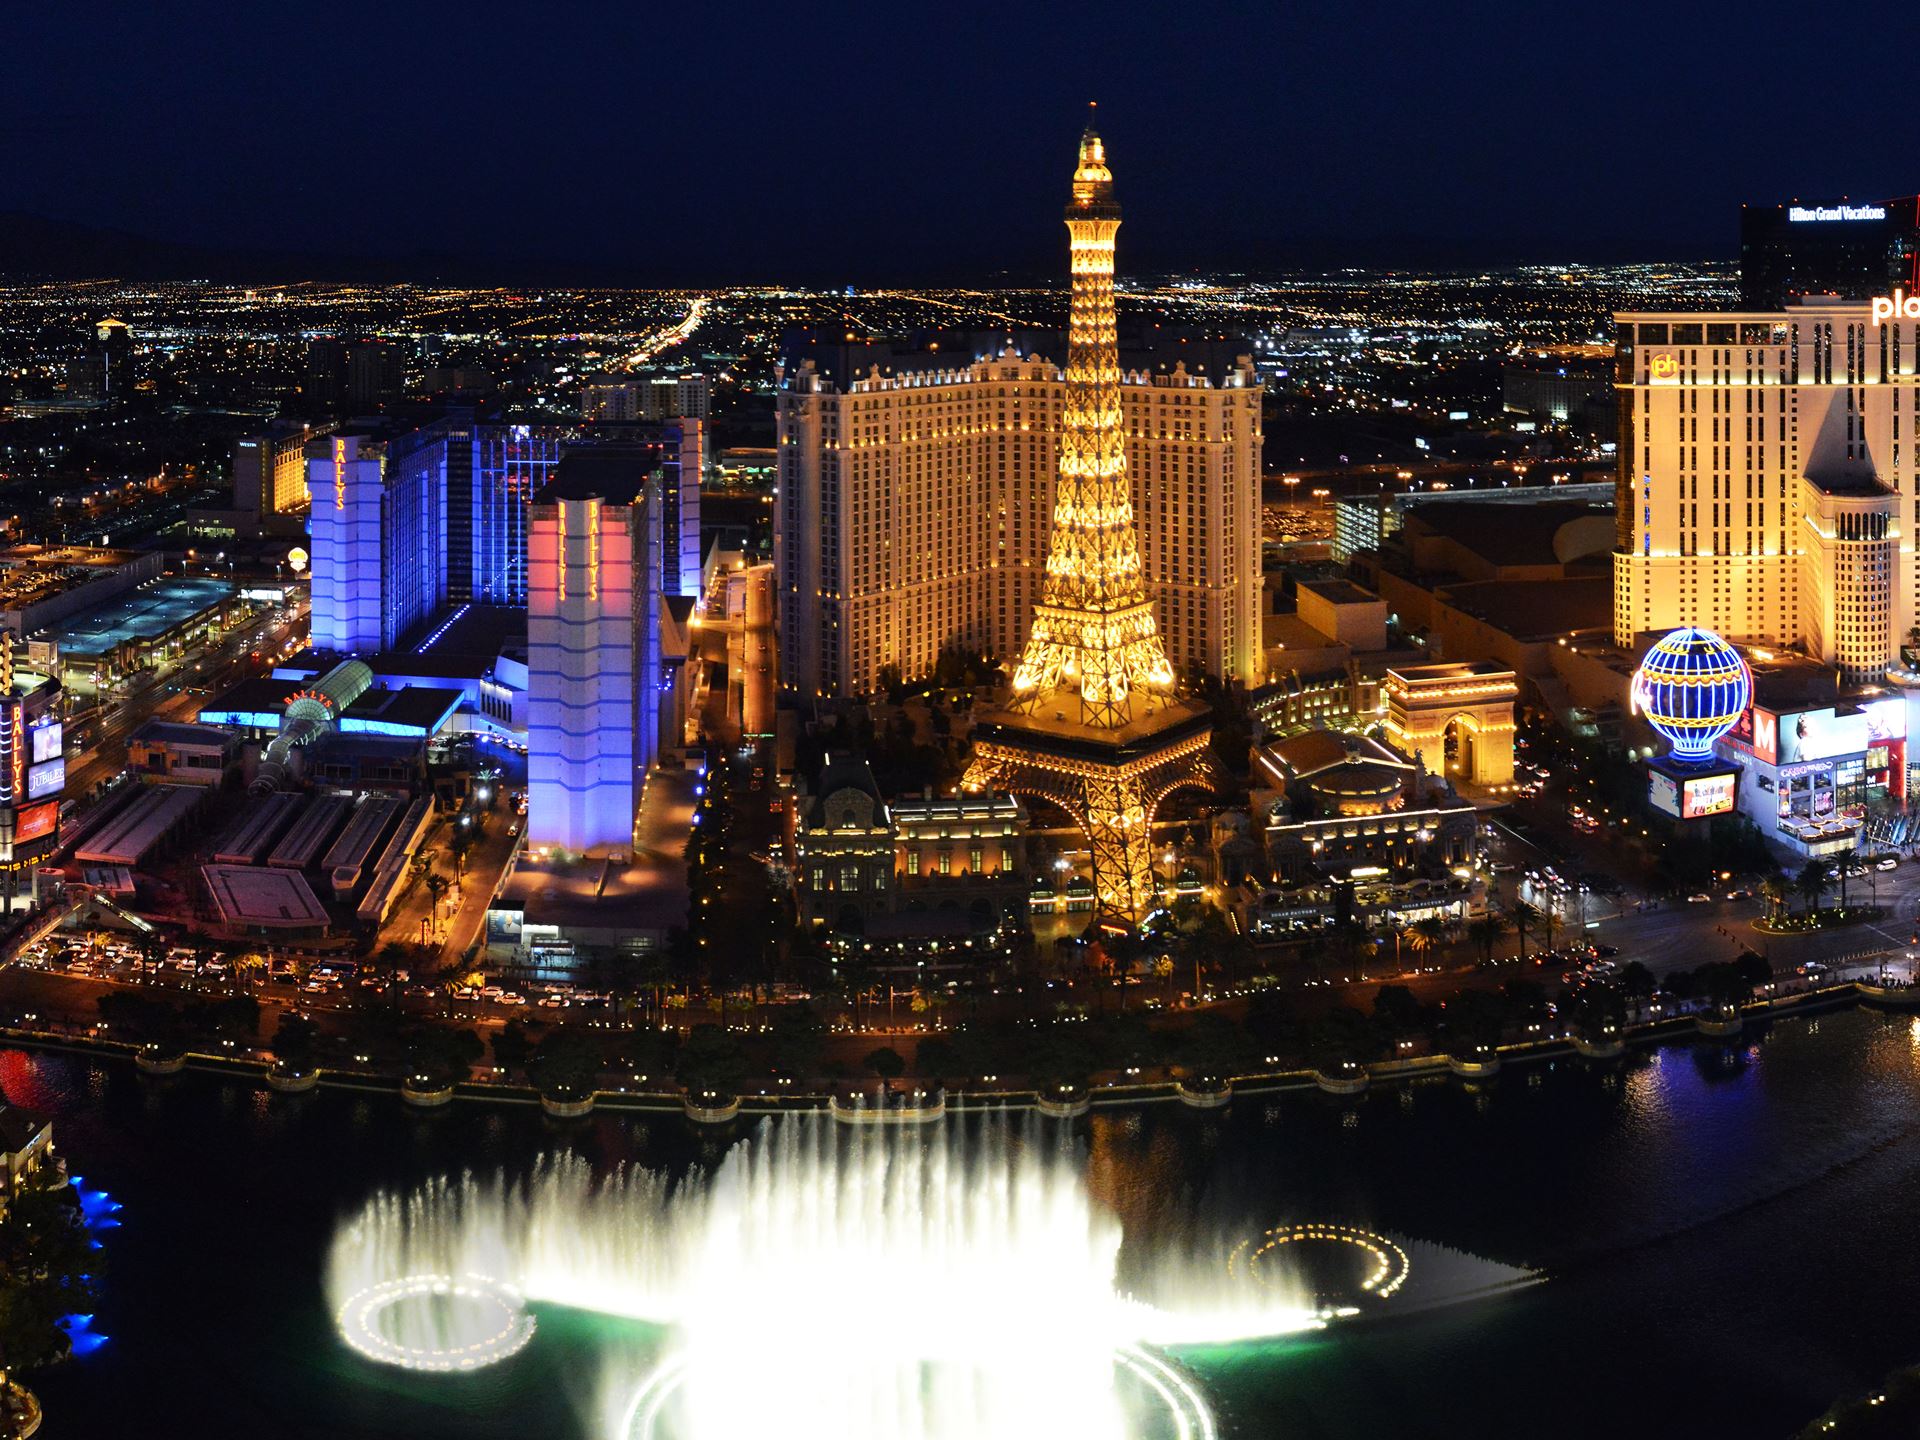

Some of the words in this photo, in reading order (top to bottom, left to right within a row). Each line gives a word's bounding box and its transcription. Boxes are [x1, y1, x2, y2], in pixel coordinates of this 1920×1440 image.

[1789, 207, 1816, 221] Hilton
[1816, 206, 1842, 221] Grand
[1842, 205, 1885, 220] Vacations
[1655, 354, 1678, 374] ph
[1755, 713, 1775, 754] M
[29, 768, 64, 792] JUBILEE
